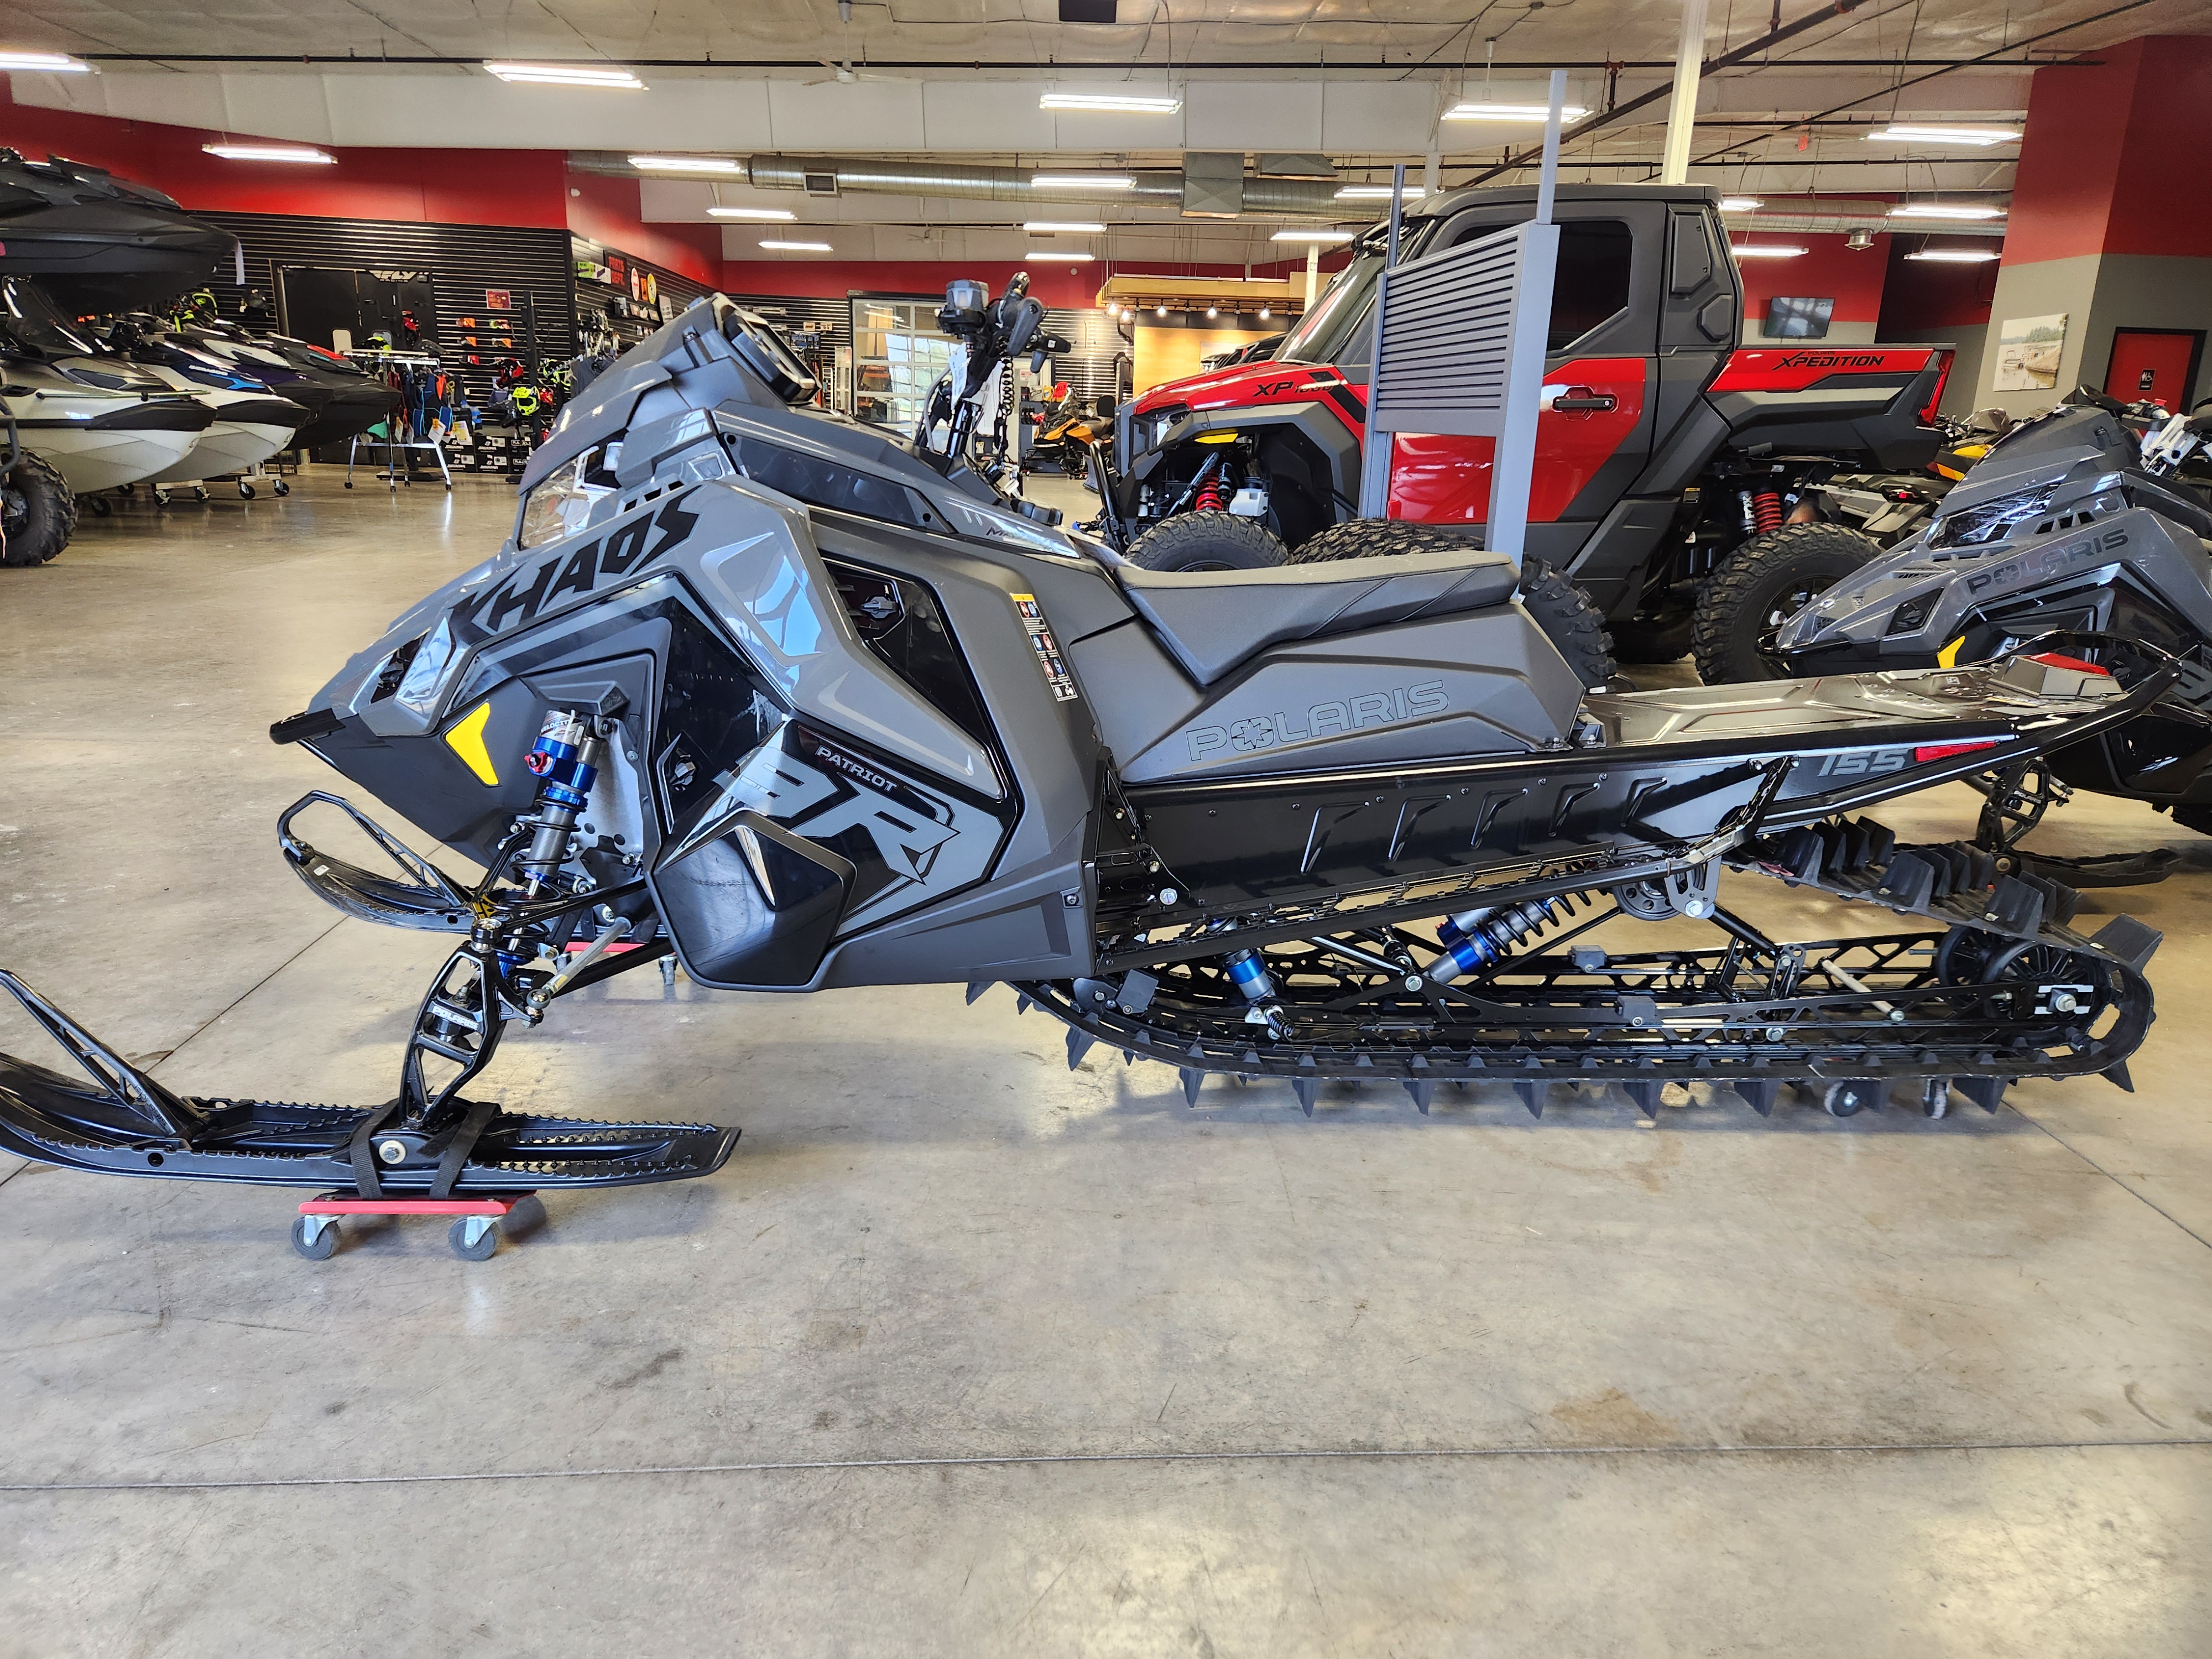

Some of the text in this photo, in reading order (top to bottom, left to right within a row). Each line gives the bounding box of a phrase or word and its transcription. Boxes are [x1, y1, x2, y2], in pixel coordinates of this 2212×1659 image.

[368, 270, 417, 280] FLY
[1771, 351, 1886, 371] XPEDITION
[1252, 381, 1294, 397] XP
[1742, 495, 1755, 520] FOX
[448, 484, 704, 646] KHAOS
[1966, 528, 2129, 596] POLARIS
[1186, 679, 1449, 762] POLARIS
[815, 744, 900, 793] PATRIOT
[1817, 747, 1908, 777] 155
[2013, 790, 2042, 805] POLARIS
[431, 1005, 479, 1031] POLARIS
